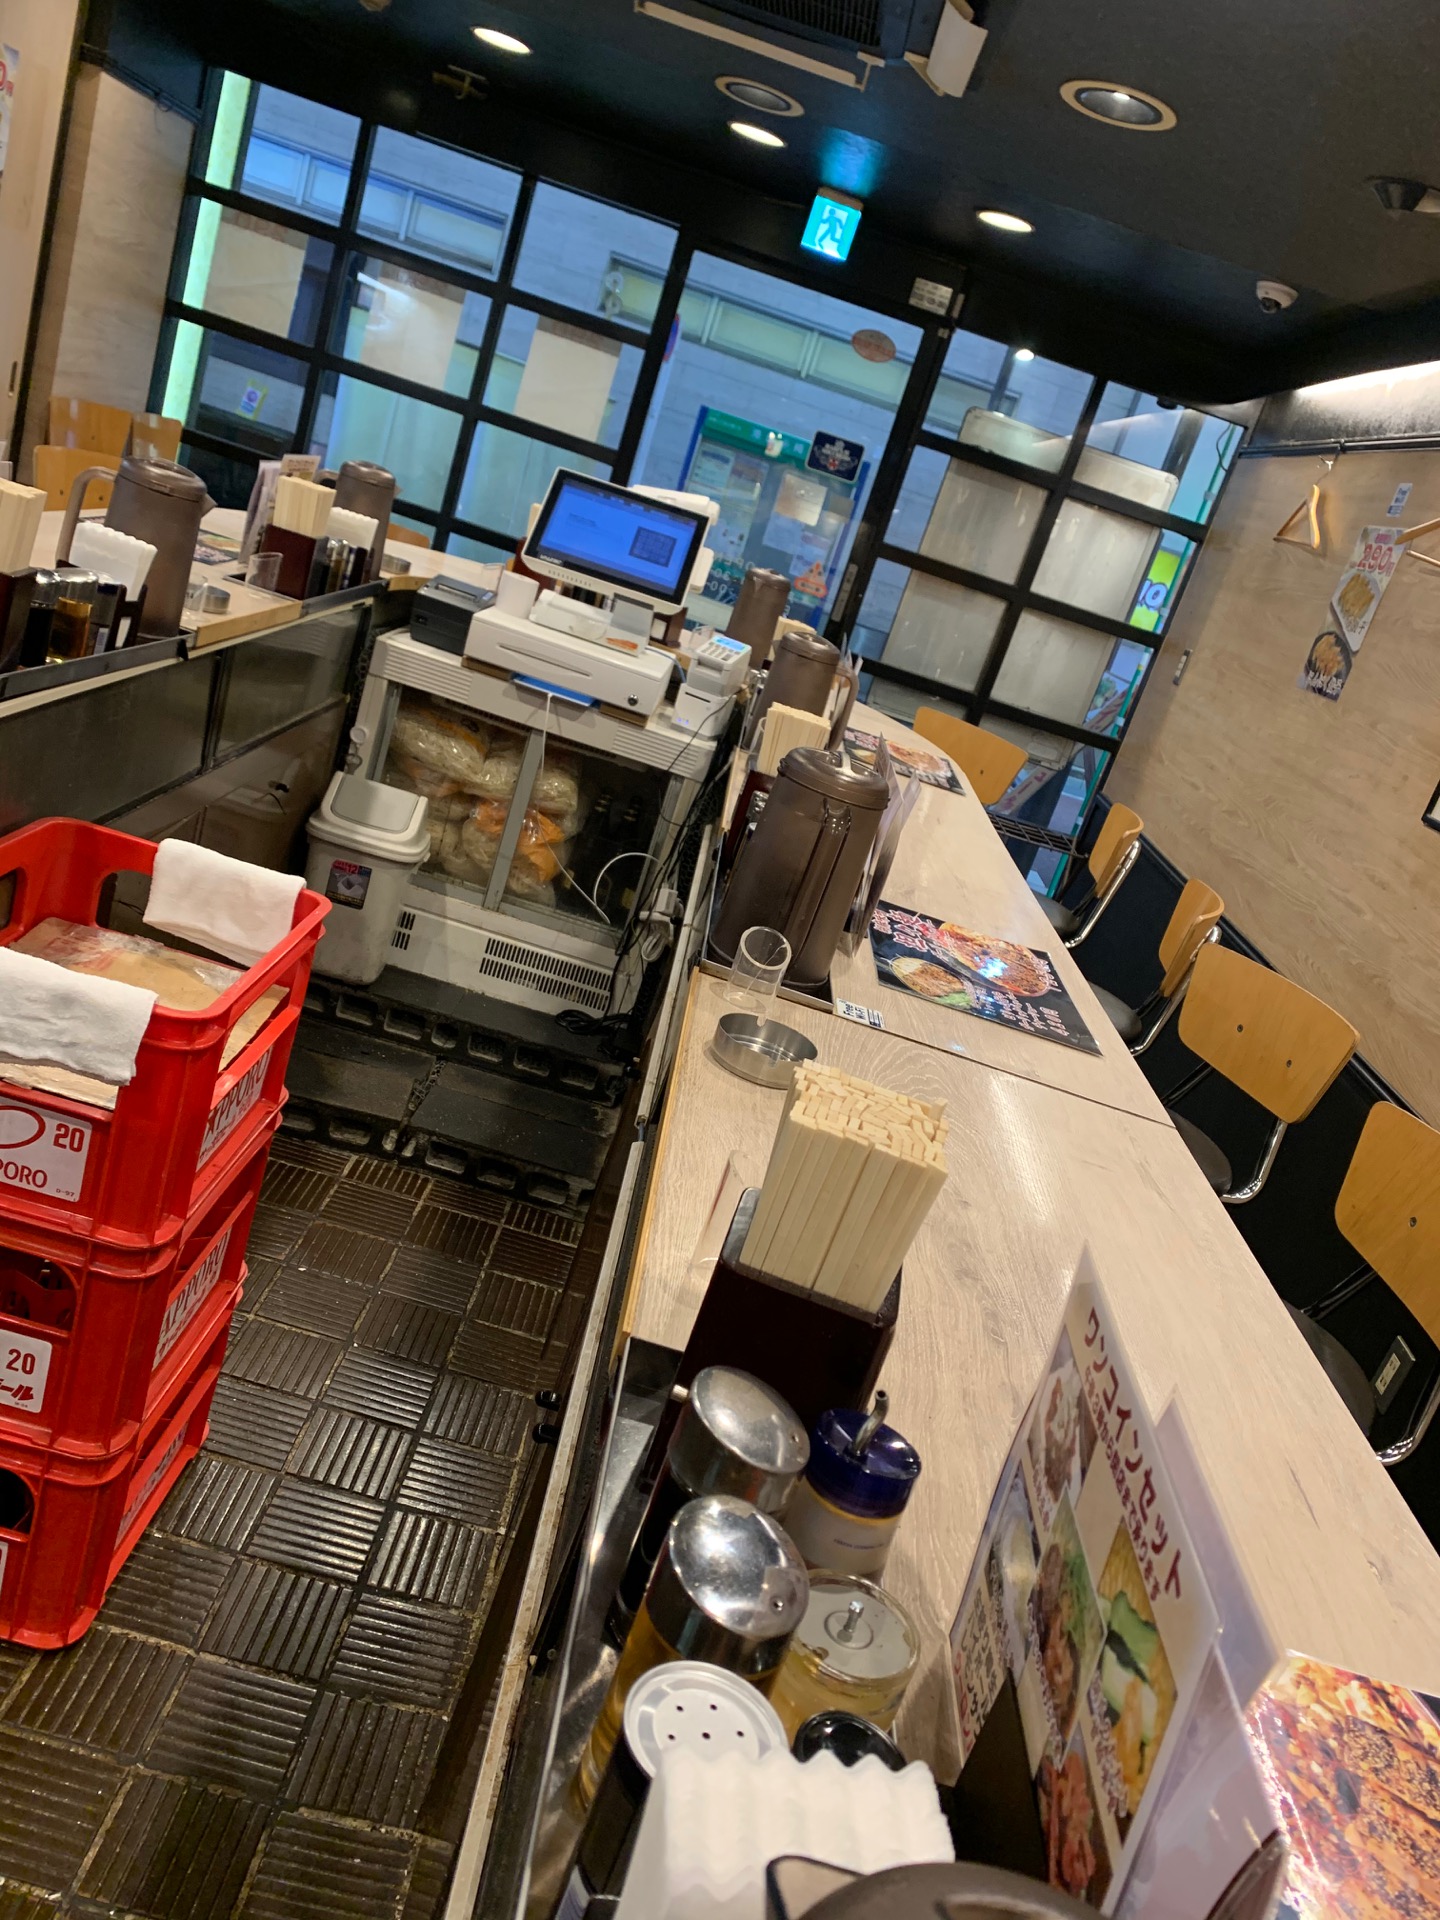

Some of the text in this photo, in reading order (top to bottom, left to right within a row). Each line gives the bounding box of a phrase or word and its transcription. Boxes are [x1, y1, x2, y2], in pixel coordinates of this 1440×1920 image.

[53, 1123, 85, 1153] 20
[6, 1348, 36, 1375] 20
[1084, 1306, 1182, 1600] ワンコインセット
